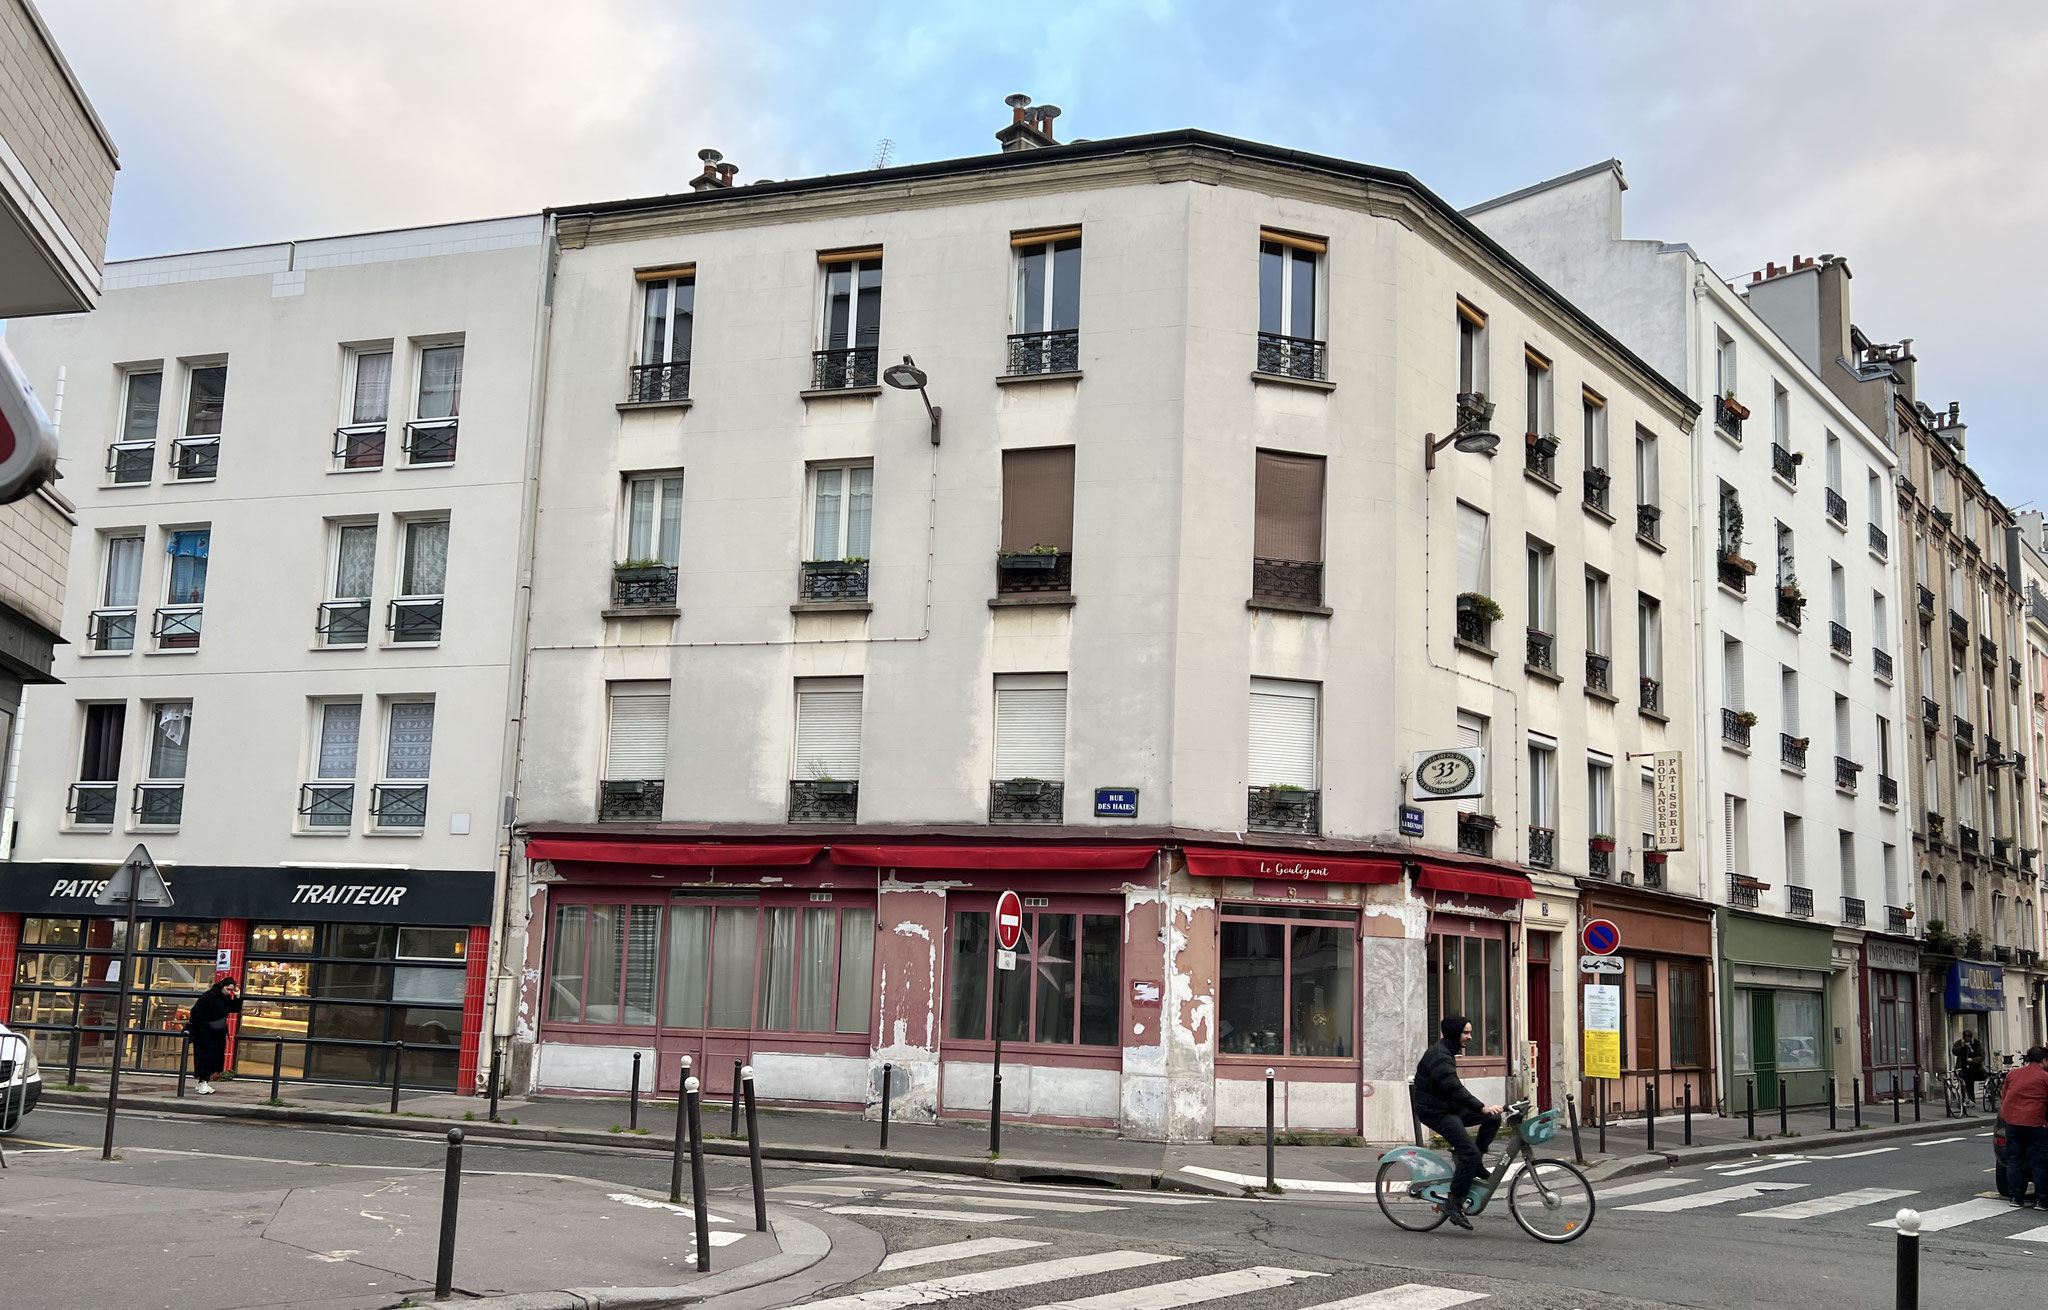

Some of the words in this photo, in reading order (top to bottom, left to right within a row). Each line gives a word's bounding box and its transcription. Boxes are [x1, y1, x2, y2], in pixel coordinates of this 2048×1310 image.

[1657, 759, 1667, 844] BOULANGERIE
[1668, 758, 1678, 844] PATISSERIE
[1260, 861, 1272, 873] Le
[1275, 862, 1329, 880] Gouleyant
[291, 884, 407, 906] TRAITEUR
[1868, 943, 1916, 969] IMPRIMERIE
